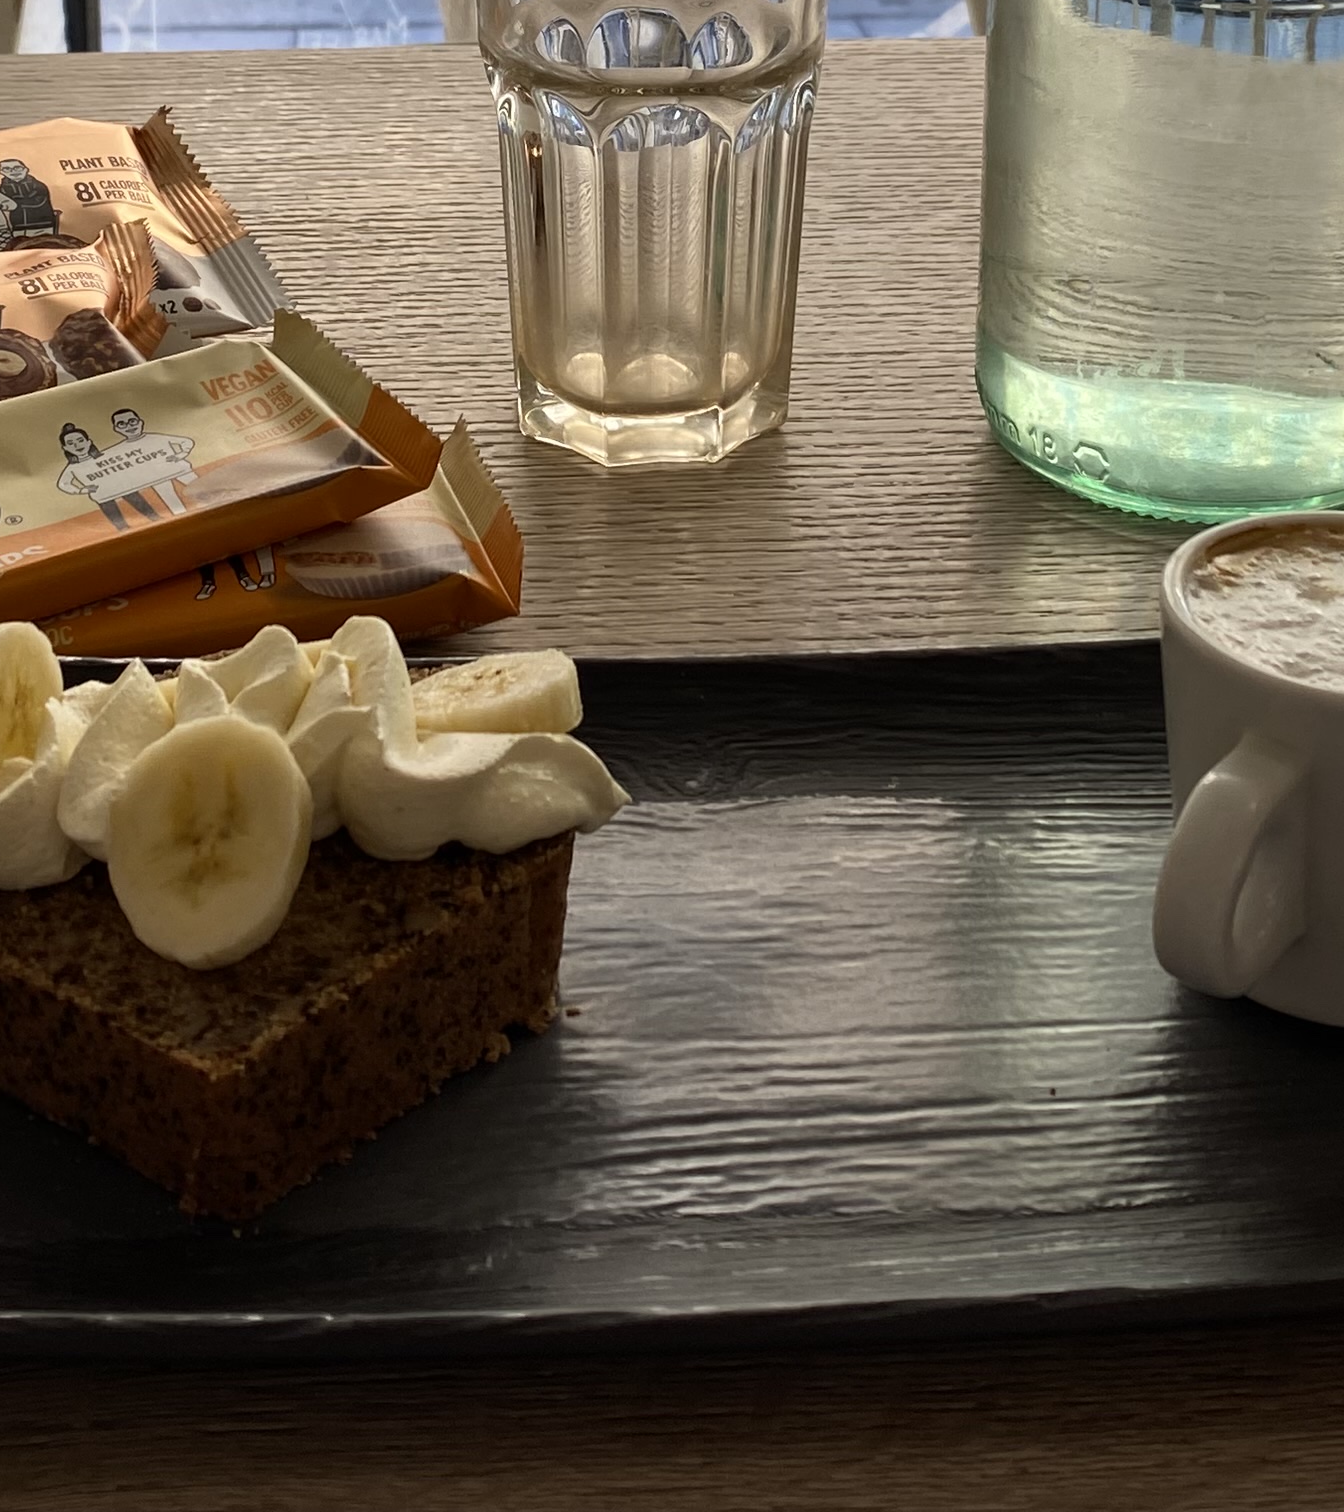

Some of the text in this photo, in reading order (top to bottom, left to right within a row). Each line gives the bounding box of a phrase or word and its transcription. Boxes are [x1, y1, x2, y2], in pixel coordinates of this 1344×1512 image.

[59, 156, 104, 172] PLANT
[73, 179, 149, 203] 81 CALORIES
[105, 189, 127, 201] PER
[4, 259, 53, 279] PLANT
[17, 277, 49, 296] 81
[51, 281, 77, 291] PER
[158, 299, 178, 315] x2
[199, 358, 277, 401] VEGAN
[243, 405, 315, 444] GLUTEN FREE
[85, 448, 169, 483] BUTTER CUPS
[95, 447, 145, 469] KISS MY
